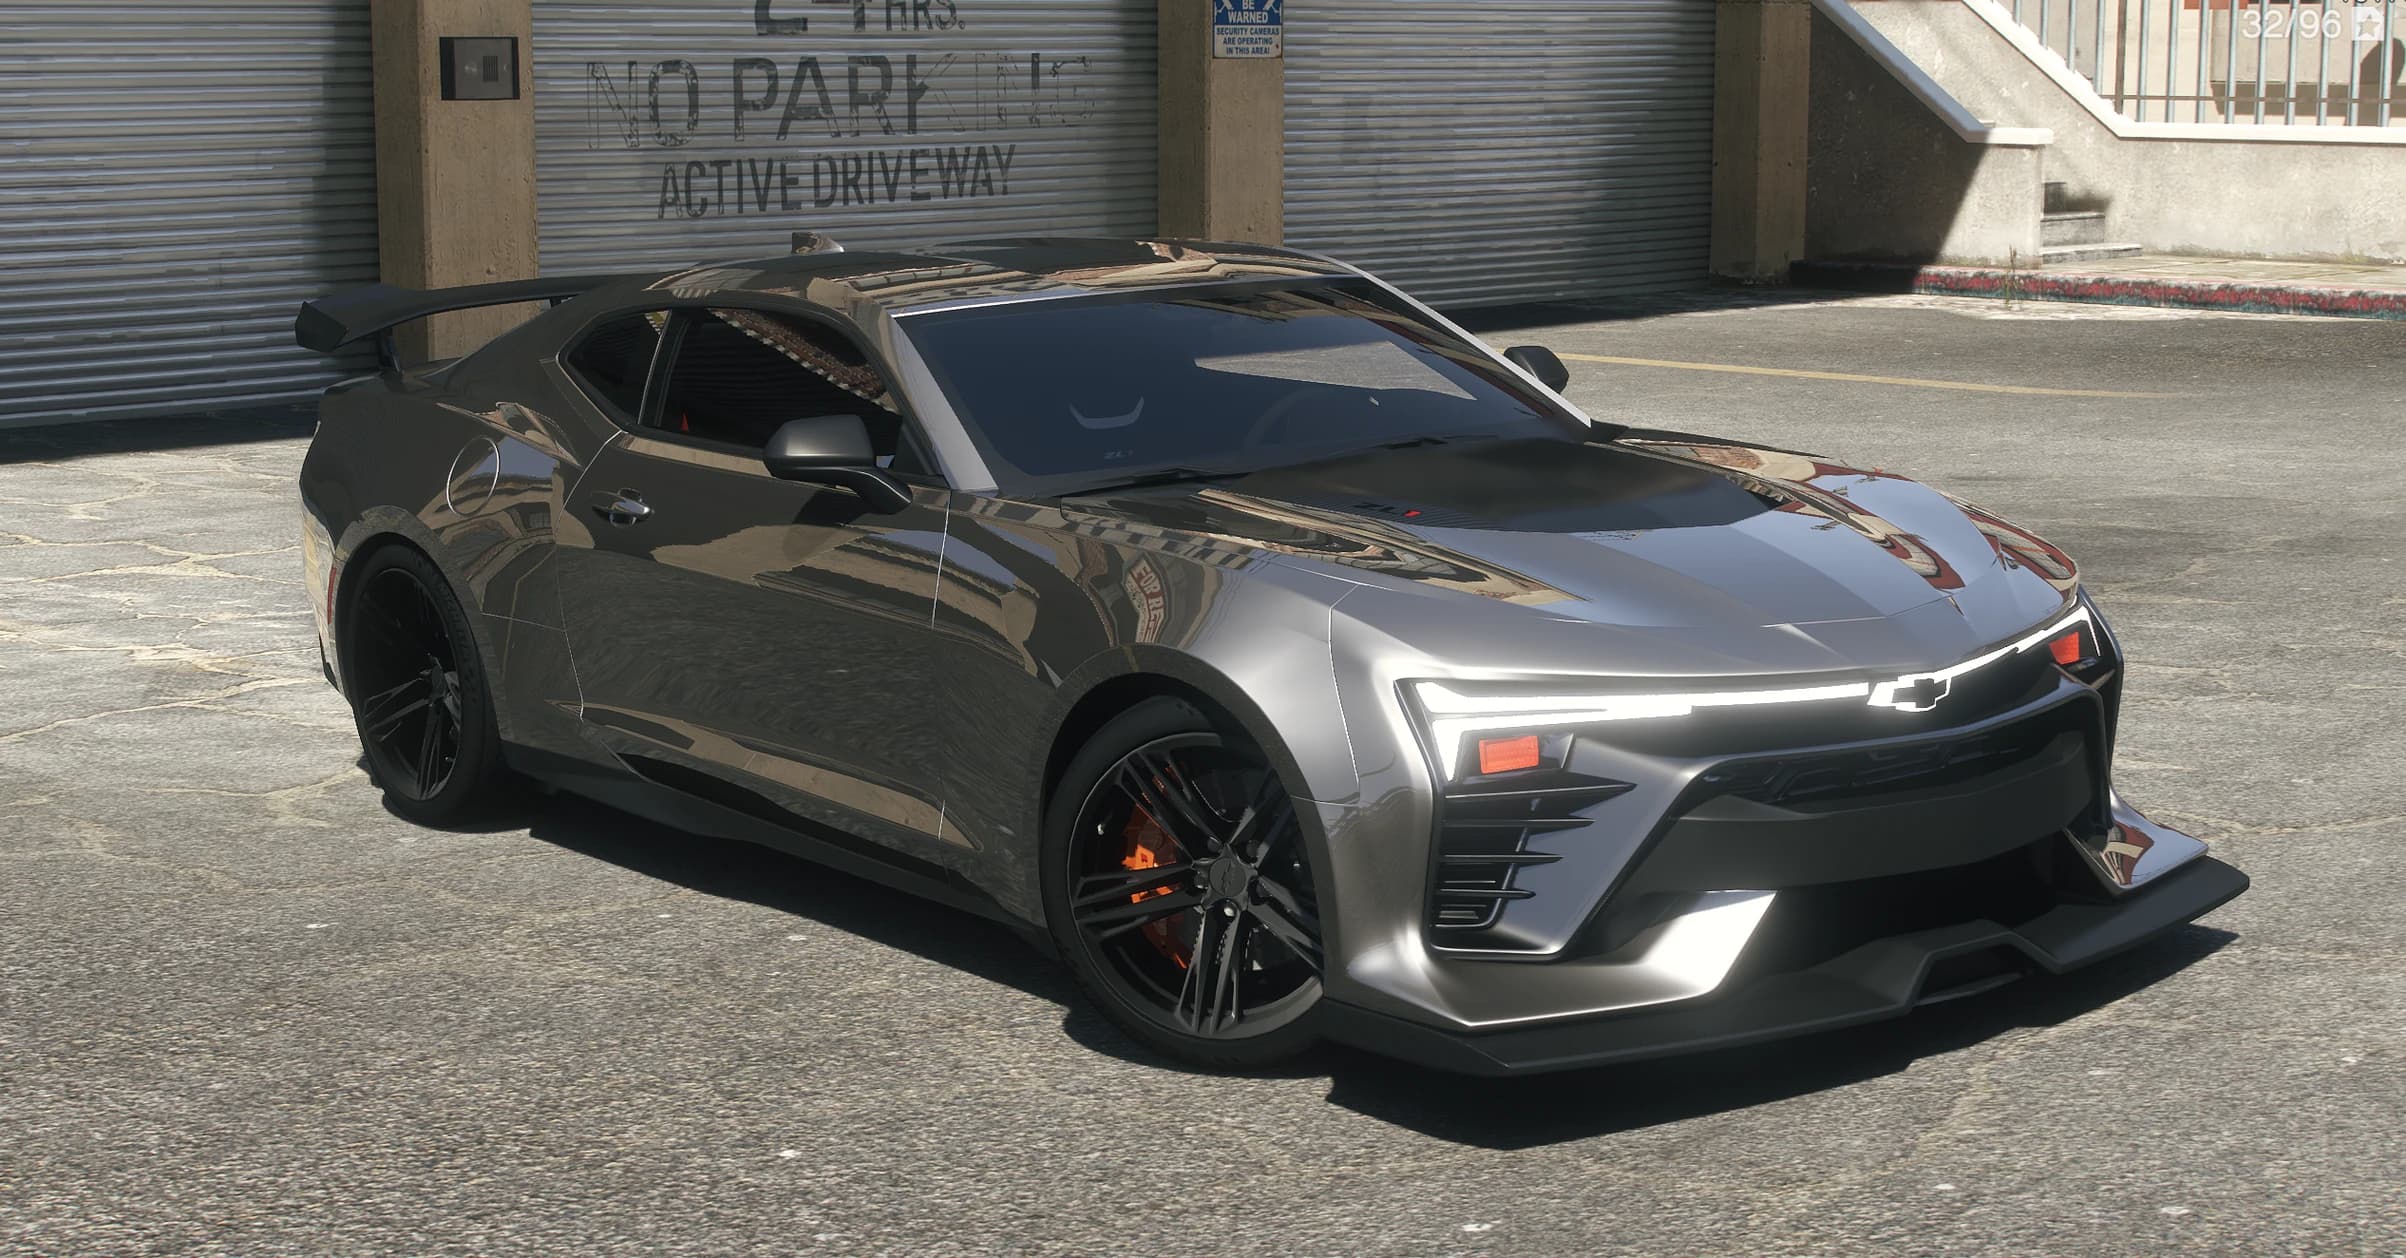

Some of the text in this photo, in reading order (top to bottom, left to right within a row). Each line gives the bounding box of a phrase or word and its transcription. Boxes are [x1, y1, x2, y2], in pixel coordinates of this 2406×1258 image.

[1242, 0, 1255, 10] BE
[1228, 11, 1269, 24] WARNED
[1216, 27, 1279, 35] SECURITY CAMERAS
[1223, 37, 1273, 45] ARE OPERATING
[1226, 47, 1234, 55] IN
[1235, 47, 1250, 55] THIS
[586, 58, 699, 150] NO
[658, 144, 1016, 219] ACTIVE DRIVEWAY
